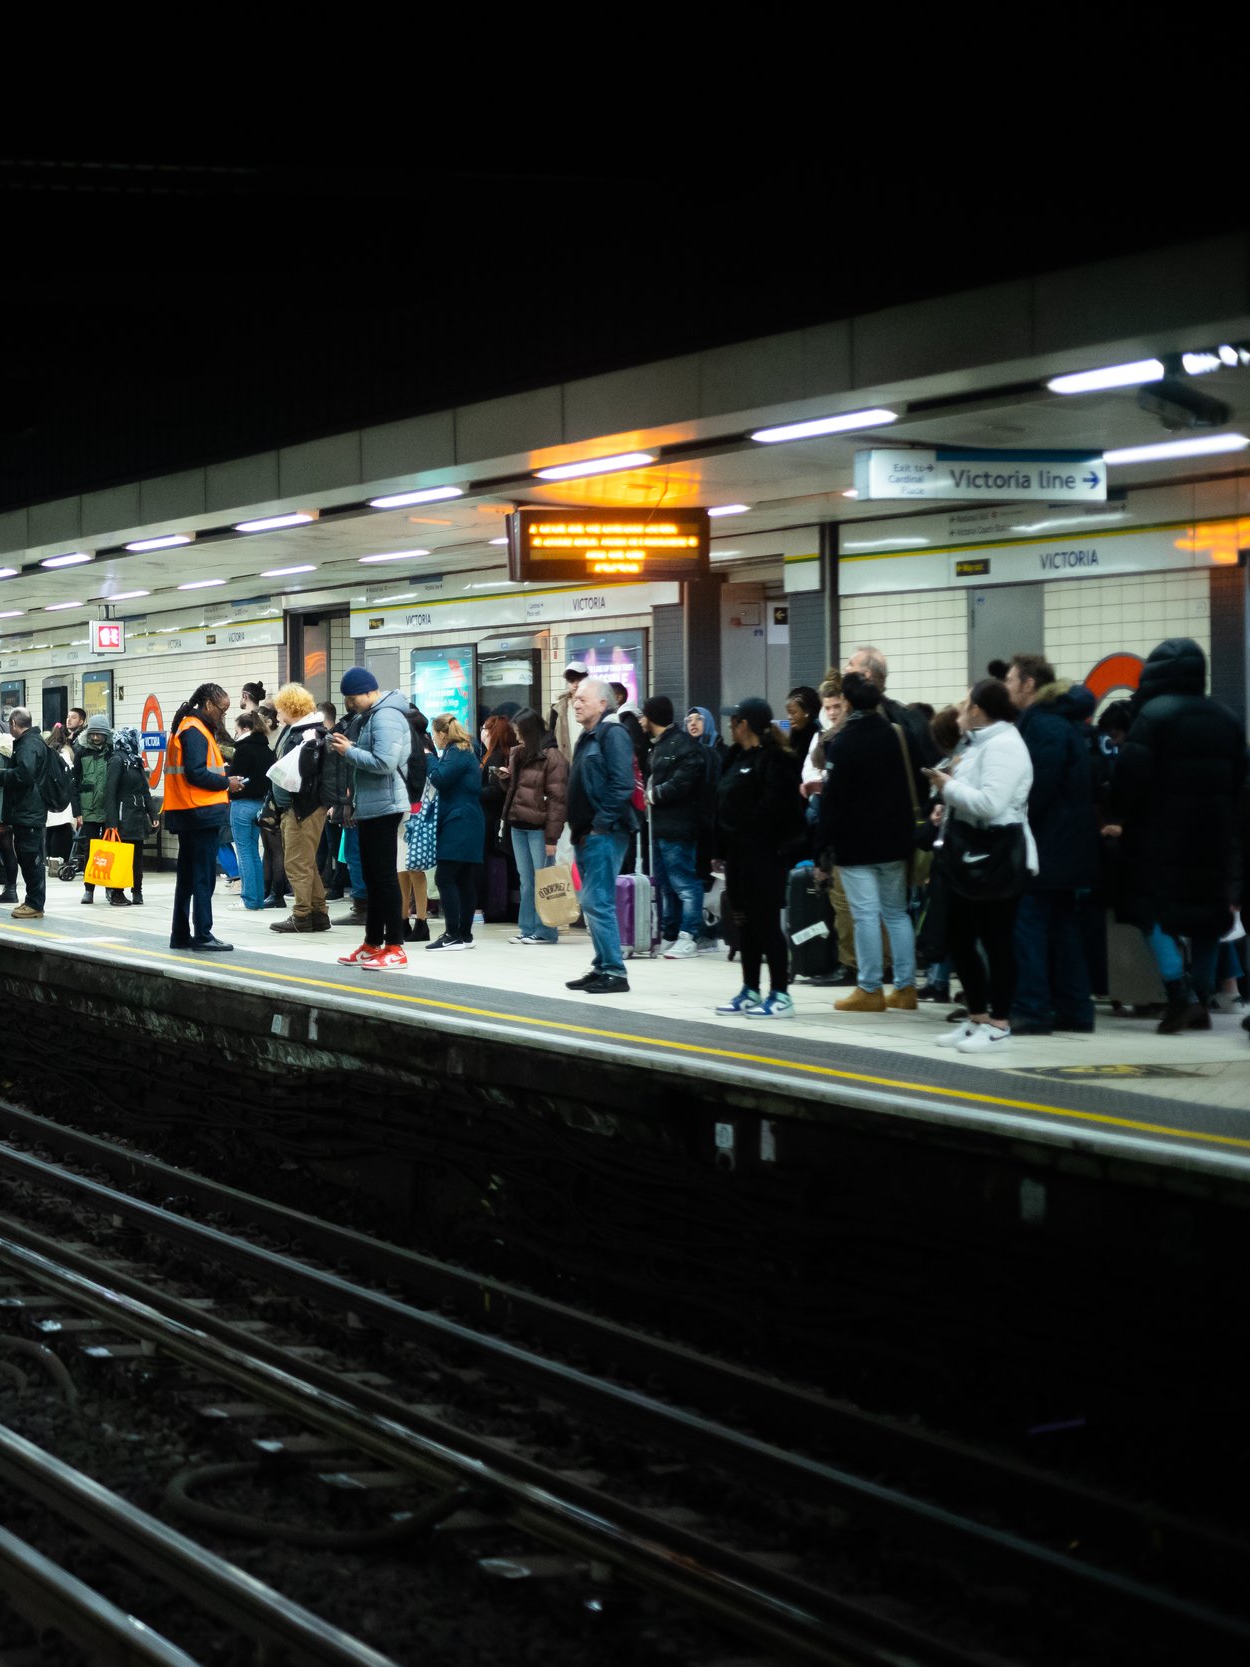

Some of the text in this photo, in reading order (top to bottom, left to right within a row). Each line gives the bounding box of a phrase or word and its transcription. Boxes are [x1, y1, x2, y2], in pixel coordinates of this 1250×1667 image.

[951, 469, 1077, 489] Victoria line
[1039, 549, 1099, 570] VICTORIA
[572, 596, 606, 611] VICTORIA
[405, 613, 432, 626] VICTORIA
